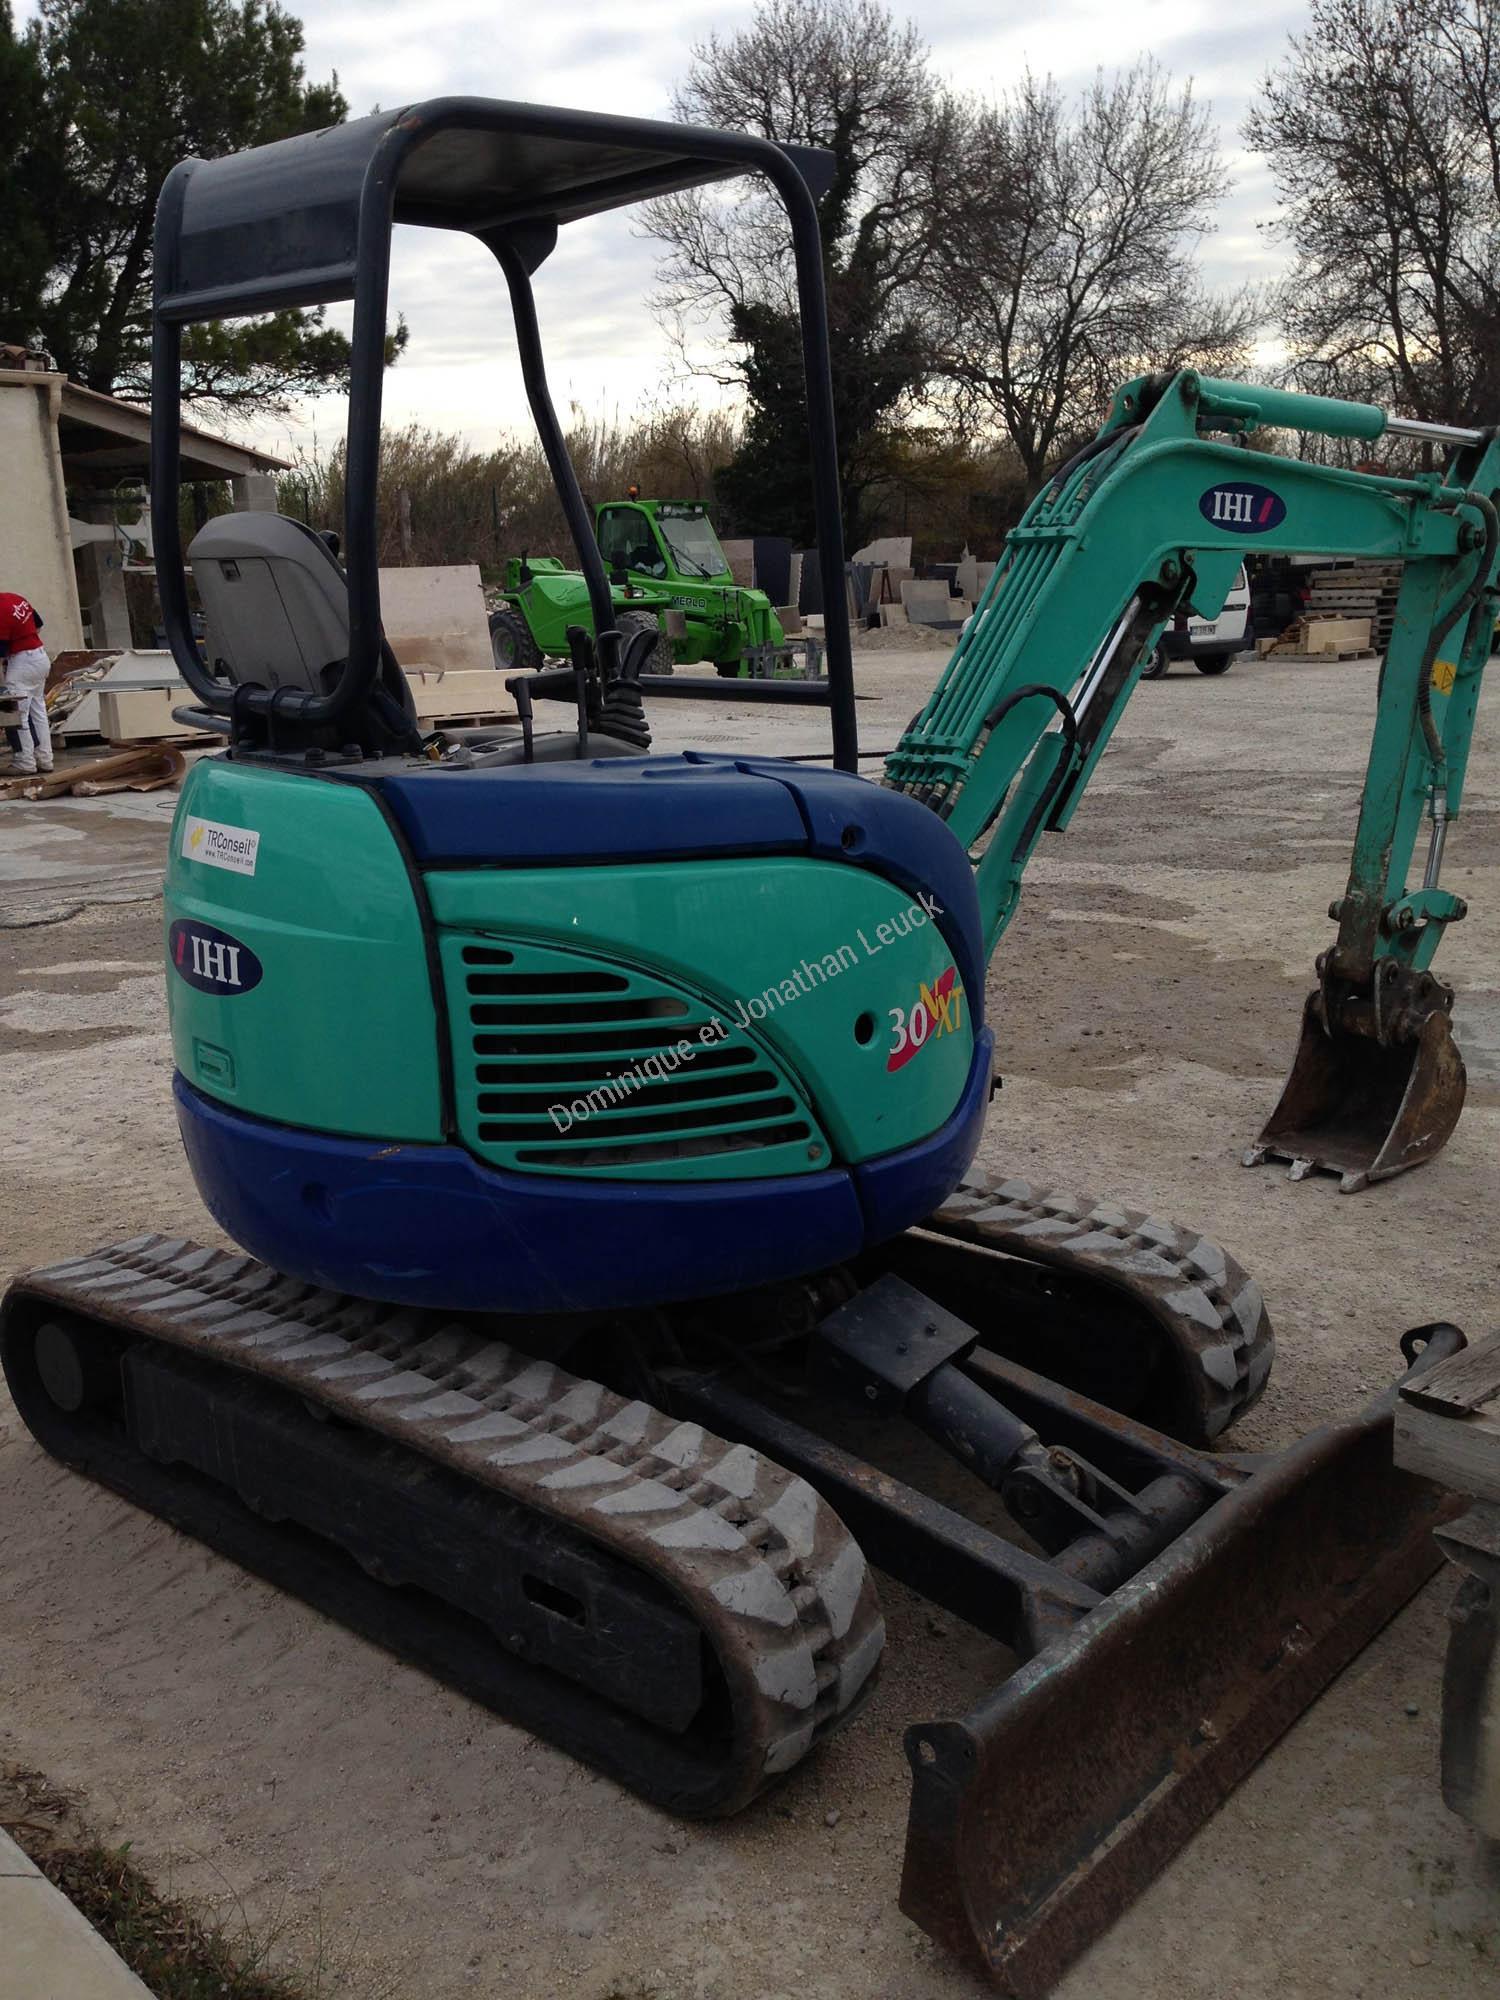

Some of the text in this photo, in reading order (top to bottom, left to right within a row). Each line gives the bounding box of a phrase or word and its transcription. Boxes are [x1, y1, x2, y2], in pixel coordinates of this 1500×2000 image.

[1212, 491, 1254, 523] IHI
[671, 595, 706, 608] MERLO
[191, 935, 242, 986] IHI
